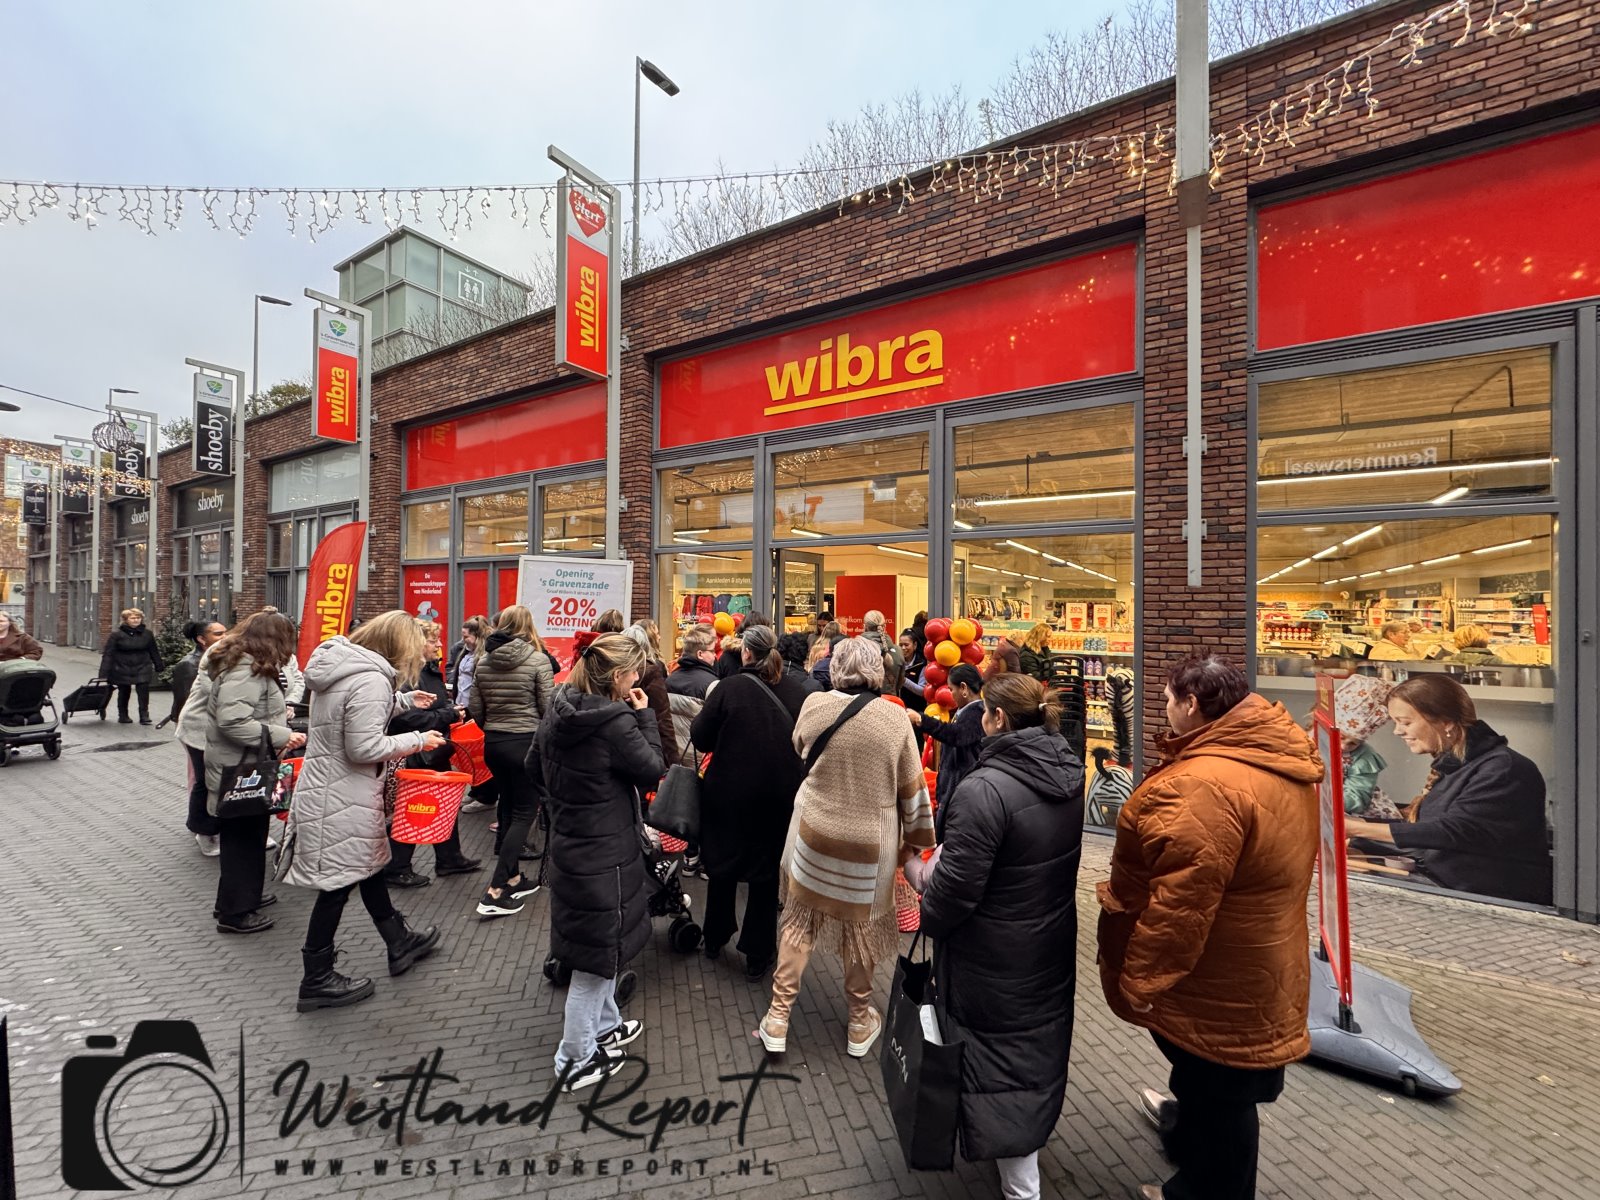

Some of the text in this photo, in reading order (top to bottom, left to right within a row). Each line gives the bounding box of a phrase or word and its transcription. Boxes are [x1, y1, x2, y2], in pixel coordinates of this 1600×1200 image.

[574, 265, 595, 347] wibra
[764, 329, 943, 401] wibra
[325, 366, 345, 423] wibra
[200, 408, 229, 471] shoeby
[116, 445, 144, 495] shoeby
[131, 505, 150, 526] shoeby
[197, 488, 224, 512] shoeby
[540, 579, 610, 590] 's Gravenzande
[556, 569, 595, 580] Opening
[316, 563, 347, 642] wibra
[548, 597, 597, 617] 20%
[407, 802, 437, 812] wibra
